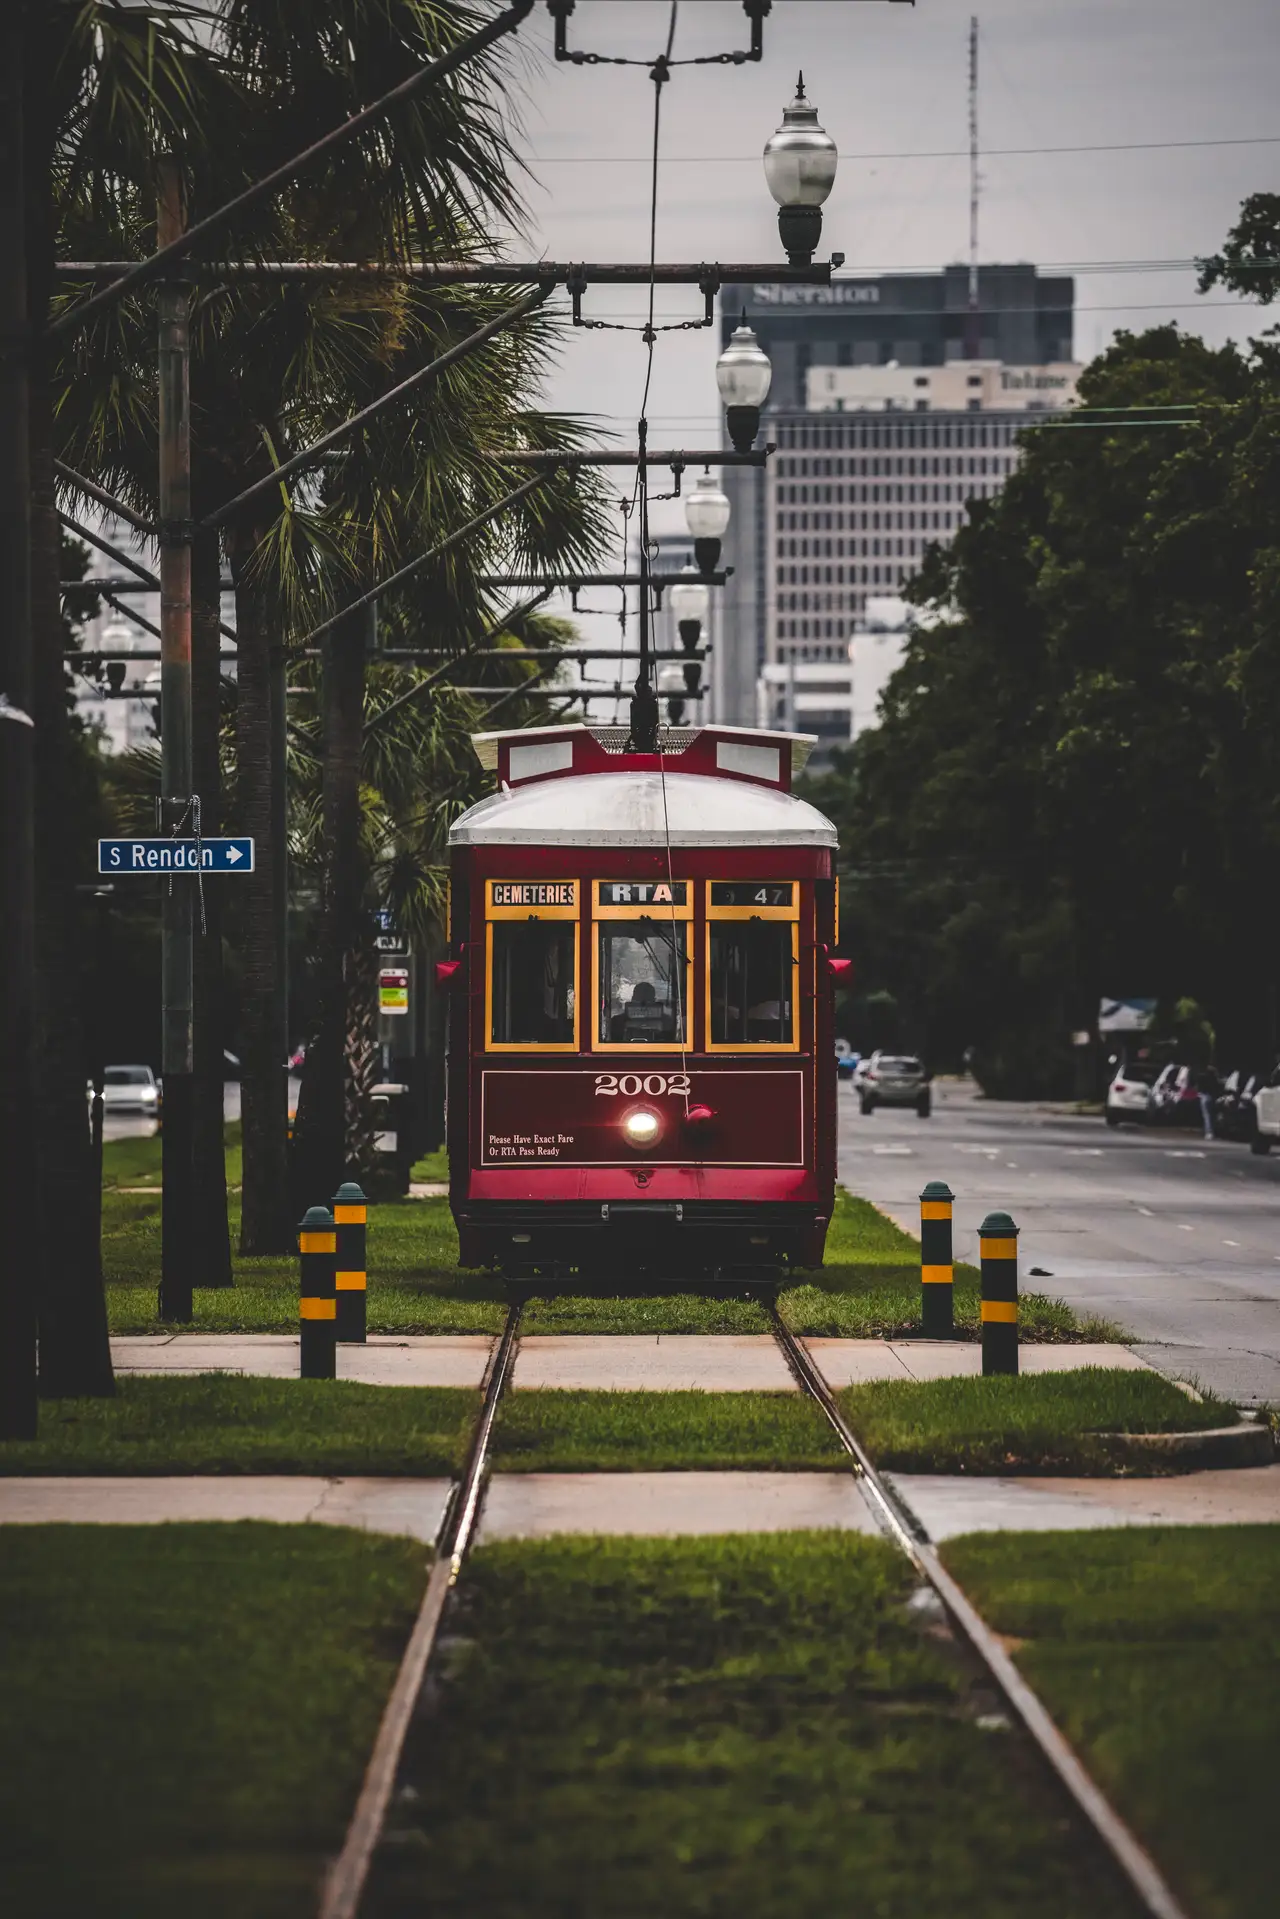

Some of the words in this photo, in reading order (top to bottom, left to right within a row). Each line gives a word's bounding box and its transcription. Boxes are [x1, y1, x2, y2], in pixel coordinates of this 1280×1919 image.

[753, 283, 880, 305] Sheraton
[110, 847, 121, 866] S
[132, 844, 213, 867] Rendon
[494, 885, 574, 904] CEMETERIES
[612, 883, 673, 902] RTA
[594, 1074, 691, 1096] 2002
[489, 1134, 511, 1144] Please
[513, 1134, 531, 1144] Have
[533, 1134, 555, 1144] Exact
[557, 1133, 574, 1143] Fare
[489, 1146, 499, 1156] Or
[501, 1146, 517, 1156] RTA
[519, 1146, 535, 1156] Pass
[537, 1146, 560, 1157] Ready
